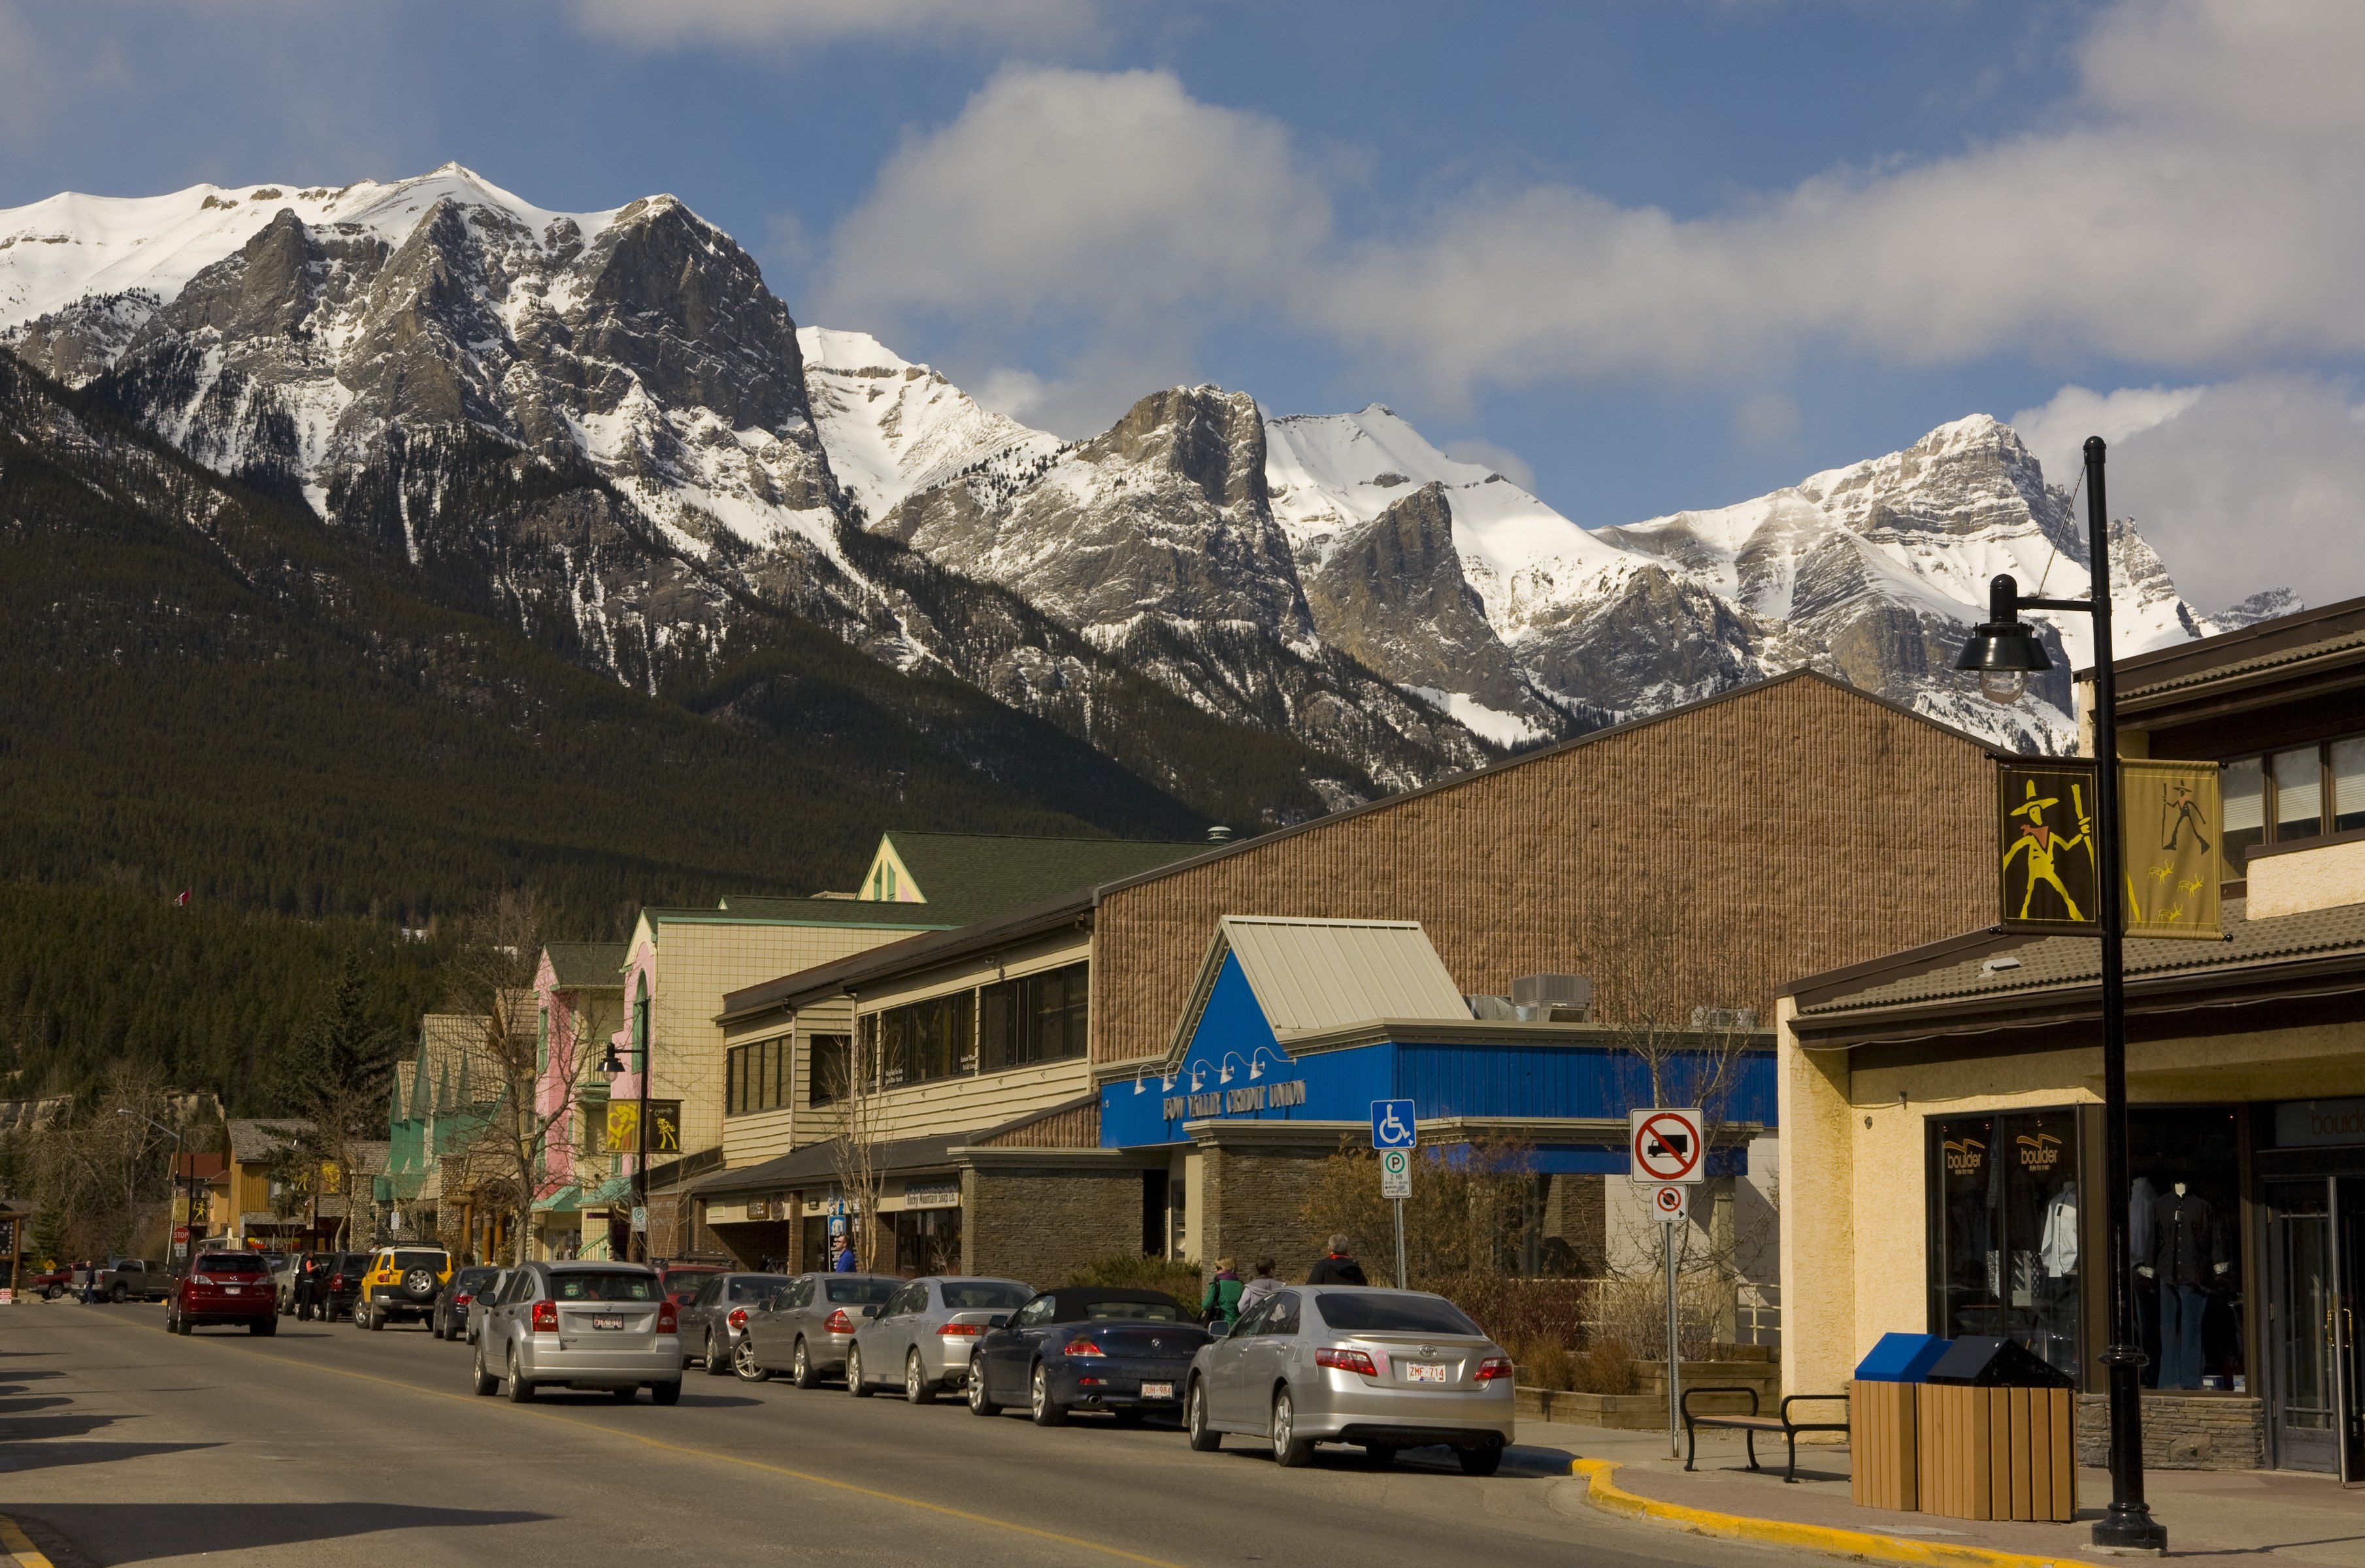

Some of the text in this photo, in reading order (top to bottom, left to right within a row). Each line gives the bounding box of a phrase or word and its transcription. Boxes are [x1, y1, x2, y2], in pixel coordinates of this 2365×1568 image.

[1163, 1080, 1306, 1120] BOW VALLEY CREDIT UNION
[1392, 1157, 1400, 1169] P
[1947, 1151, 1981, 1169] boulder
[2021, 1147, 2057, 1164] boulder
[907, 1193, 919, 1207] Rocky
[919, 1191, 938, 1204] Mountain
[938, 1192, 948, 1205] Soap
